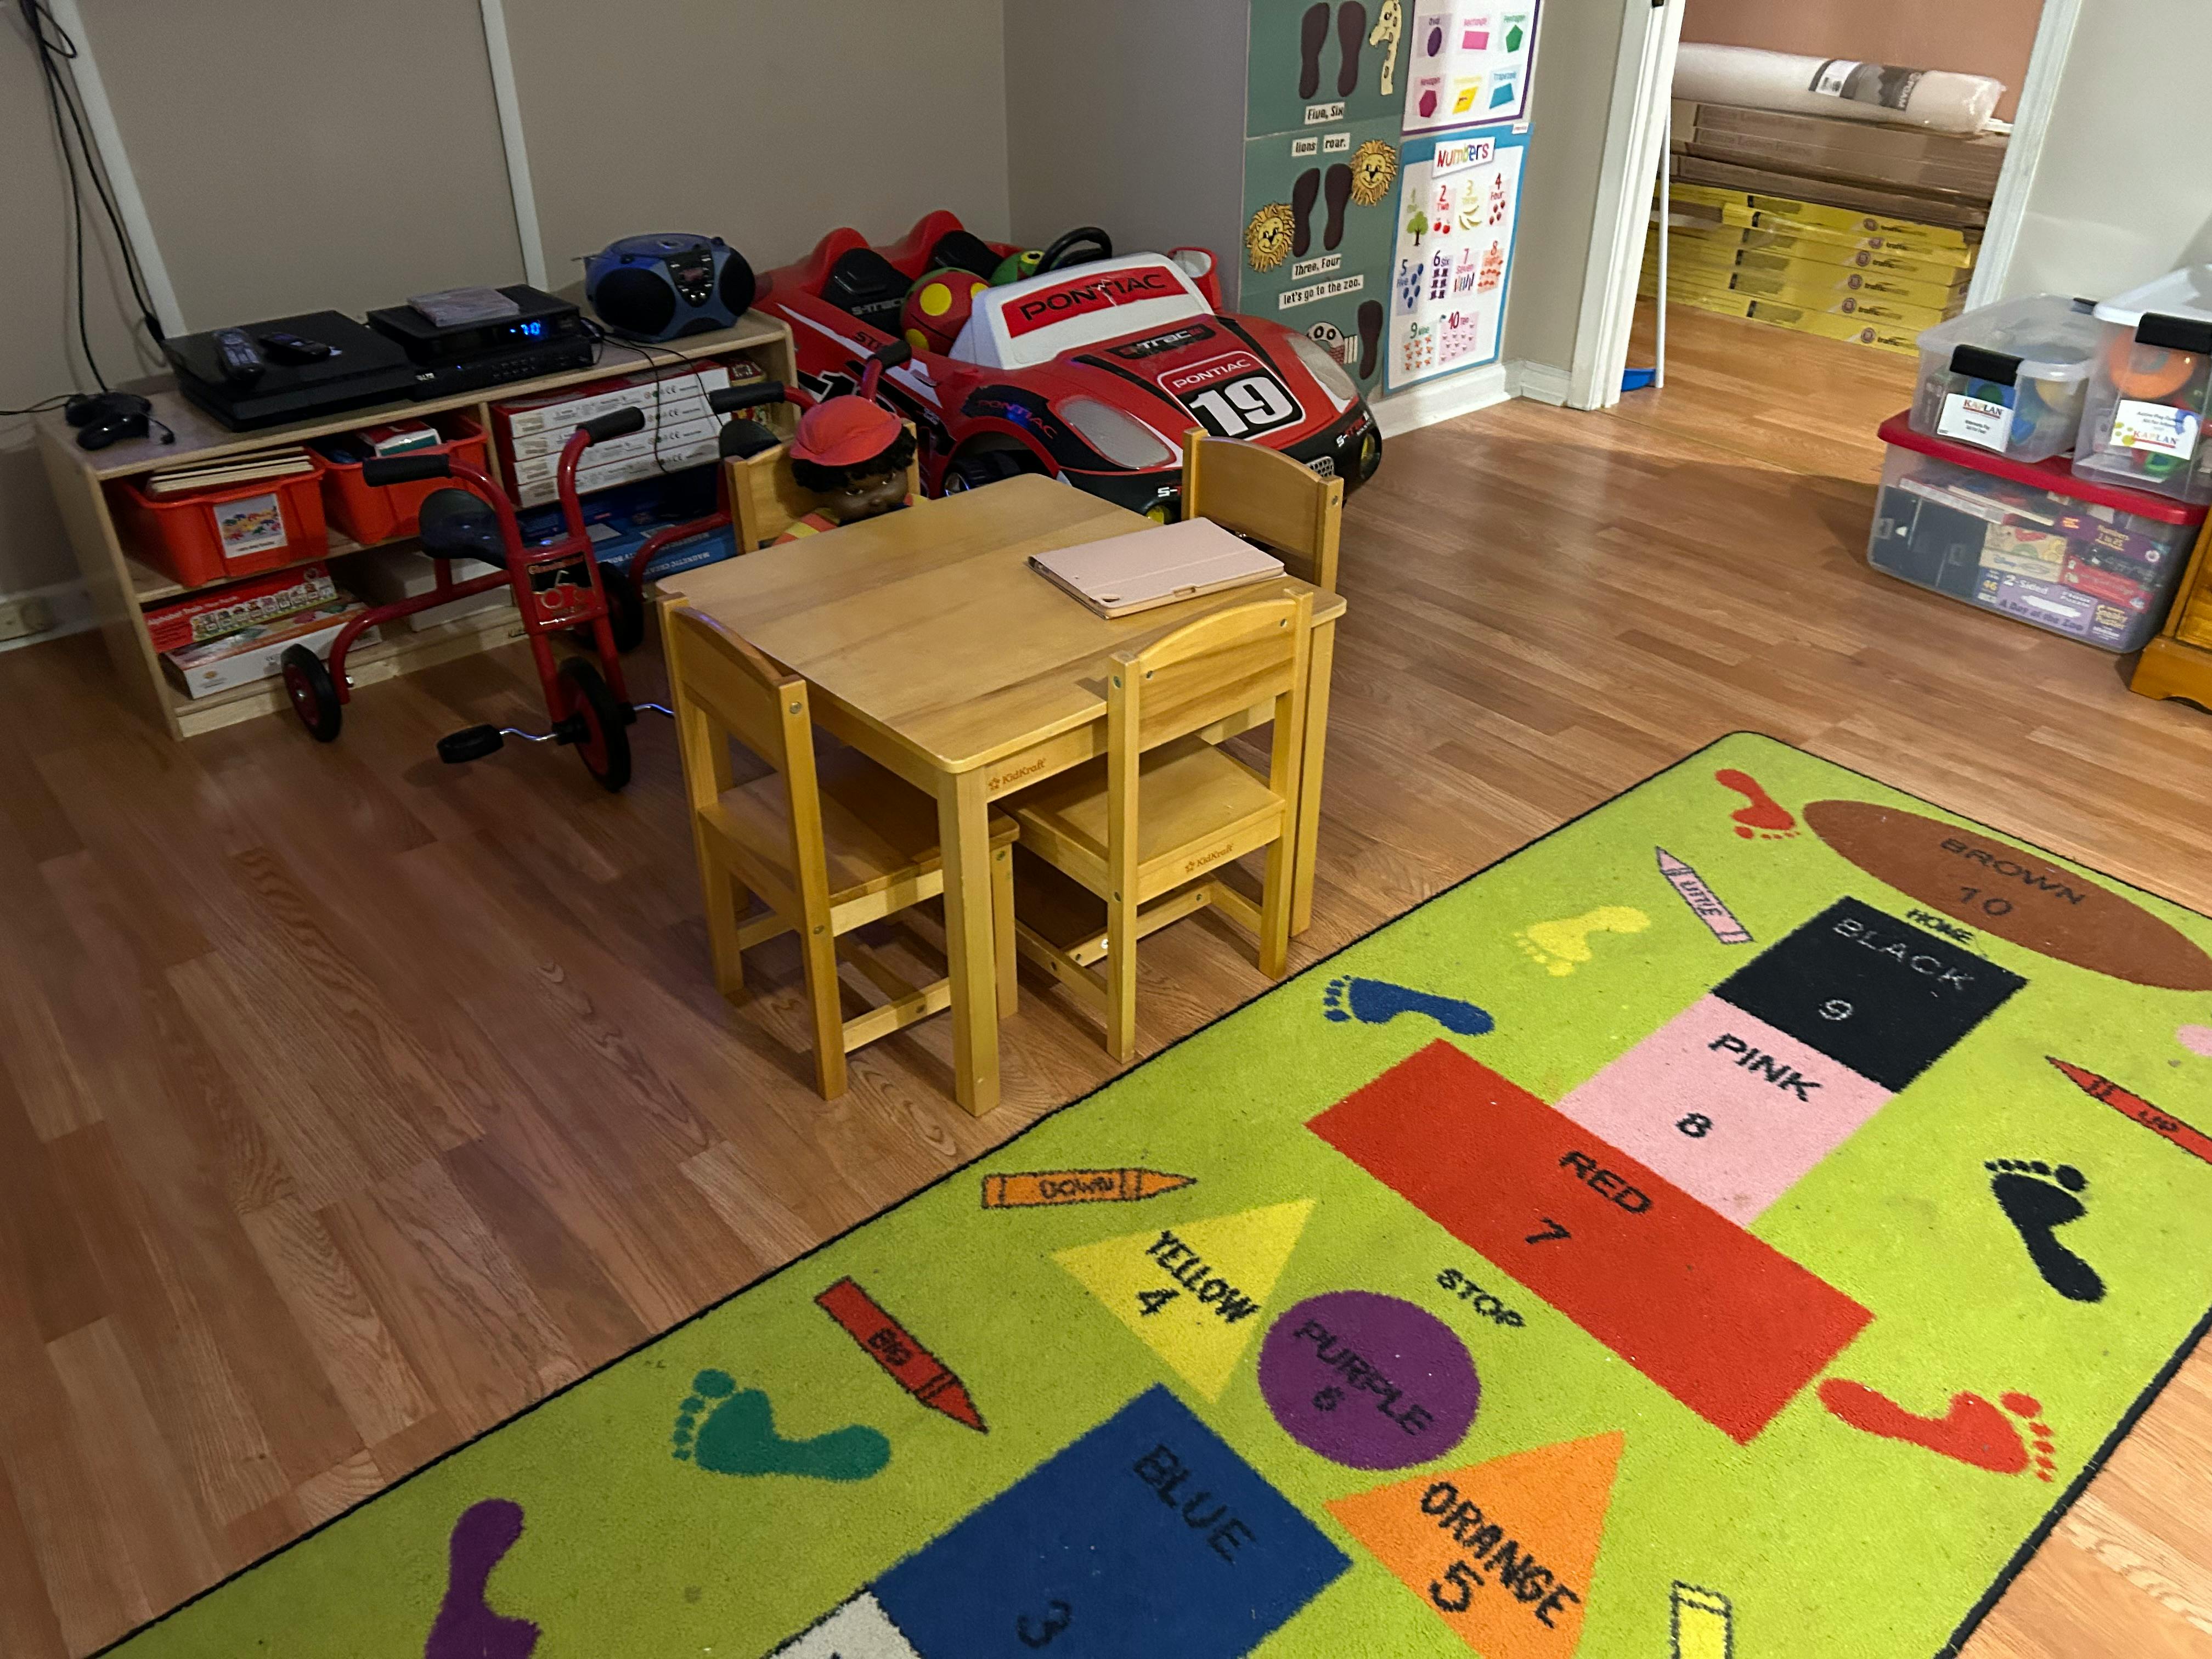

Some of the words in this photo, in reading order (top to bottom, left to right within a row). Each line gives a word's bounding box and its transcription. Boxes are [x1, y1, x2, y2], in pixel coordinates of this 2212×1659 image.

[1307, 108, 1328, 120] Five,
[1331, 106, 1344, 116] Six
[1296, 142, 1316, 153] lions
[1325, 138, 1346, 149] roar.
[1437, 143, 1489, 167] Numbers
[1440, 185, 1447, 202] 2
[1495, 173, 1502, 189] 4
[1434, 250, 1441, 267] 6
[1464, 248, 1470, 264] 7
[1491, 240, 1498, 256] 8
[1295, 263, 1319, 276] Three,
[1322, 257, 1340, 268] Four
[1401, 259, 1408, 276] 5
[1019, 274, 1167, 321] PONTIAC
[1284, 291, 1302, 304] let's
[1304, 289, 1314, 302] go
[1317, 285, 1325, 295] to
[1328, 282, 1341, 294] the
[1344, 278, 1361, 290] zoo.
[1409, 321, 1418, 339] 9
[1448, 311, 1459, 329] 10
[1172, 358, 1251, 389] PONTIAC
[977, 399, 1058, 439] PONTIAC
[1189, 375, 1294, 437] 19
[1963, 399, 2004, 416] KAPLAN
[2133, 430, 2177, 445] KAPLAN
[1002, 758, 1047, 785] KidKraft
[1197, 843, 1234, 867] KidKraft
[1940, 837, 2085, 905] BROWN
[1959, 885, 2013, 917] 10
[1906, 908, 1976, 945] HOME
[1833, 917, 1975, 991] BLACK
[1819, 999, 1854, 1022] 9
[1707, 1032, 1824, 1103] PINK
[1675, 1112, 1713, 1138] 8
[1039, 1176, 1114, 1199] DOWN
[1559, 1150, 1654, 1215] RED
[1525, 1217, 1572, 1245] 7
[1145, 1229, 1263, 1324] YELLOW
[1135, 1288, 1181, 1317] 4
[1435, 1267, 1527, 1328] STOP
[1293, 1318, 1435, 1436] PURPLE
[1131, 1443, 1257, 1565] BLUE
[1419, 1480, 1582, 1629] ORANGE
[1429, 1559, 1485, 1614] 5
[1017, 1599, 1073, 1648] 3
